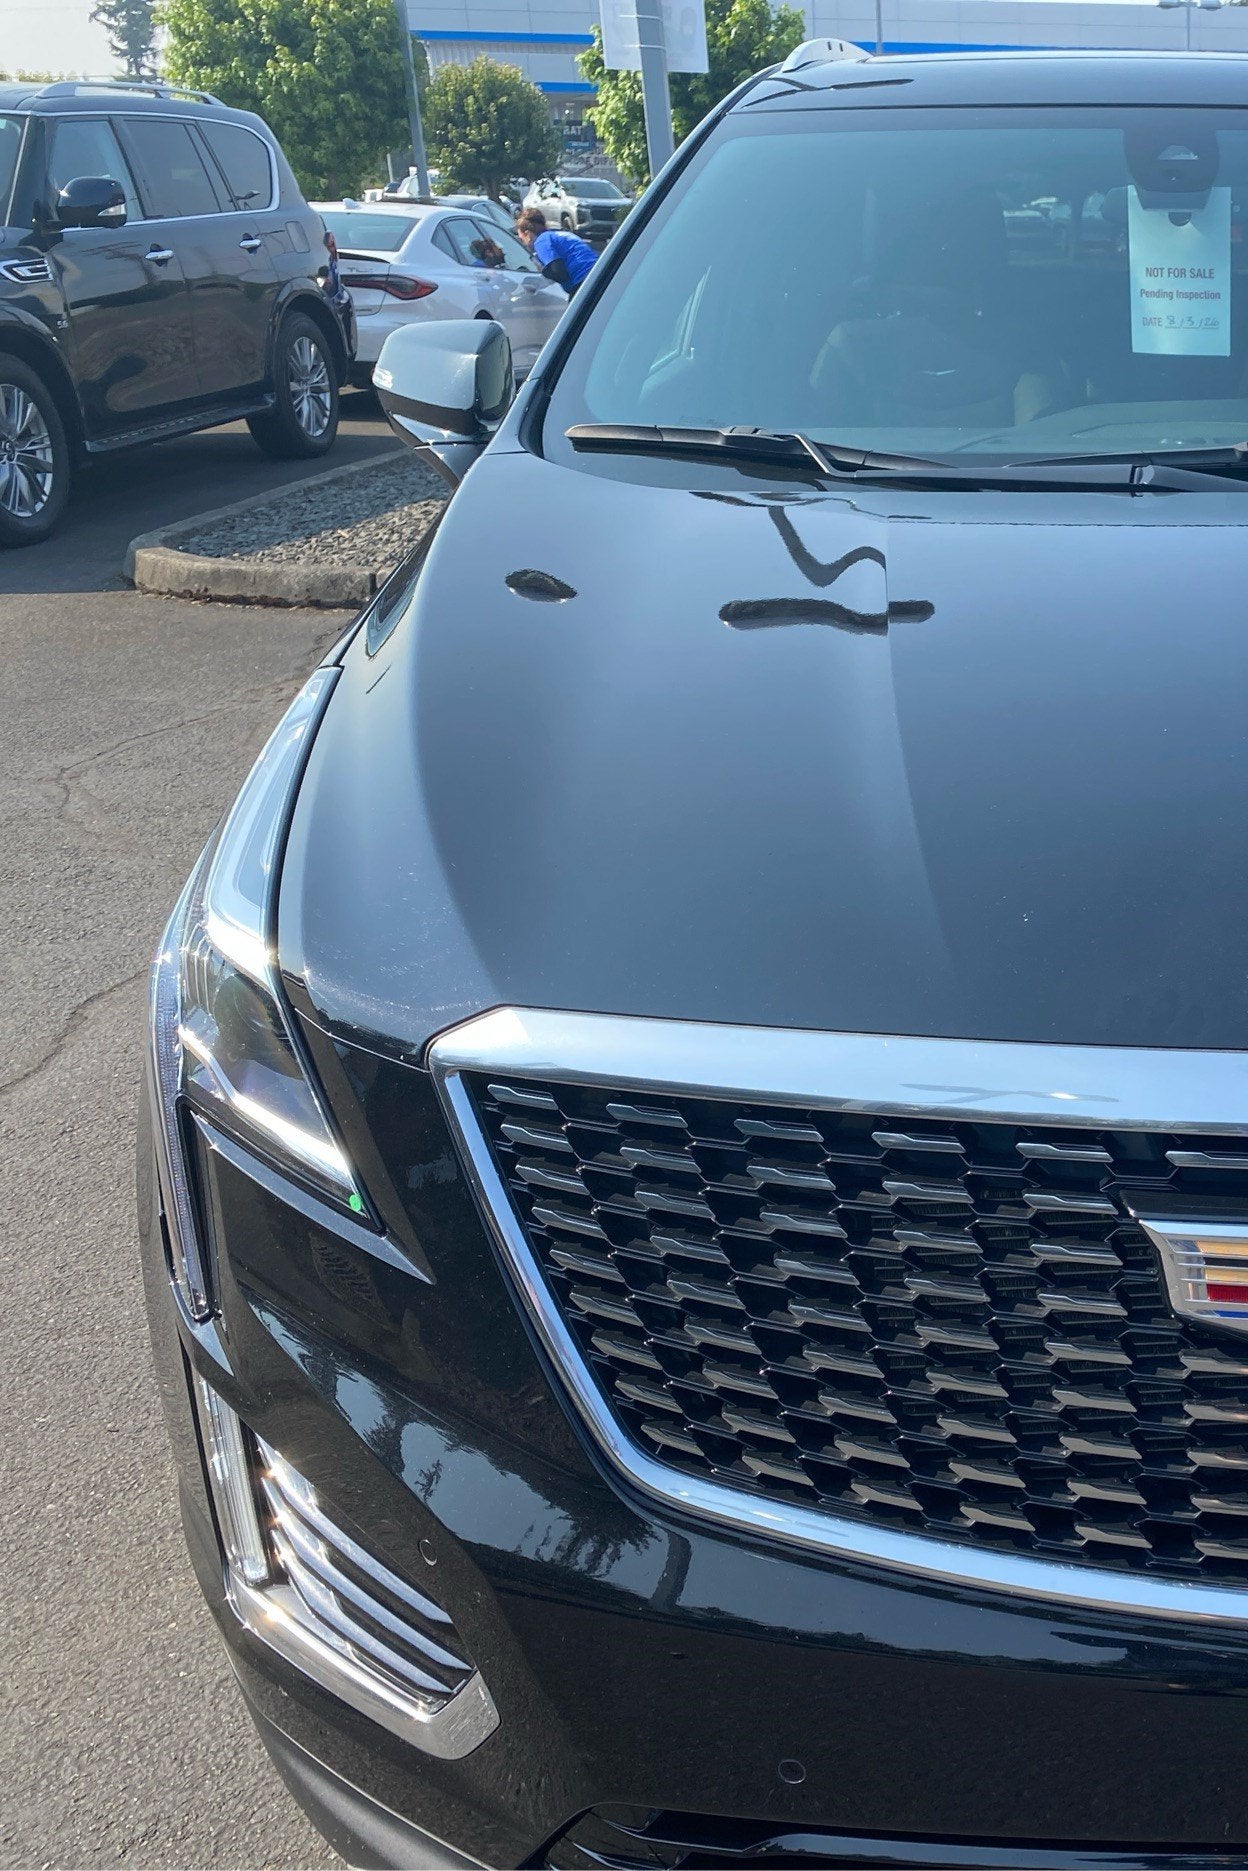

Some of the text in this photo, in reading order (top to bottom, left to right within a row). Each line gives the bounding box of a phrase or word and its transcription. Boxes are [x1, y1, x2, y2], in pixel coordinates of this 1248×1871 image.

[1145, 267, 1215, 279] NOT FOR SALE
[1140, 288, 1221, 301] Pending Inspection
[1142, 316, 1163, 327] DATE
